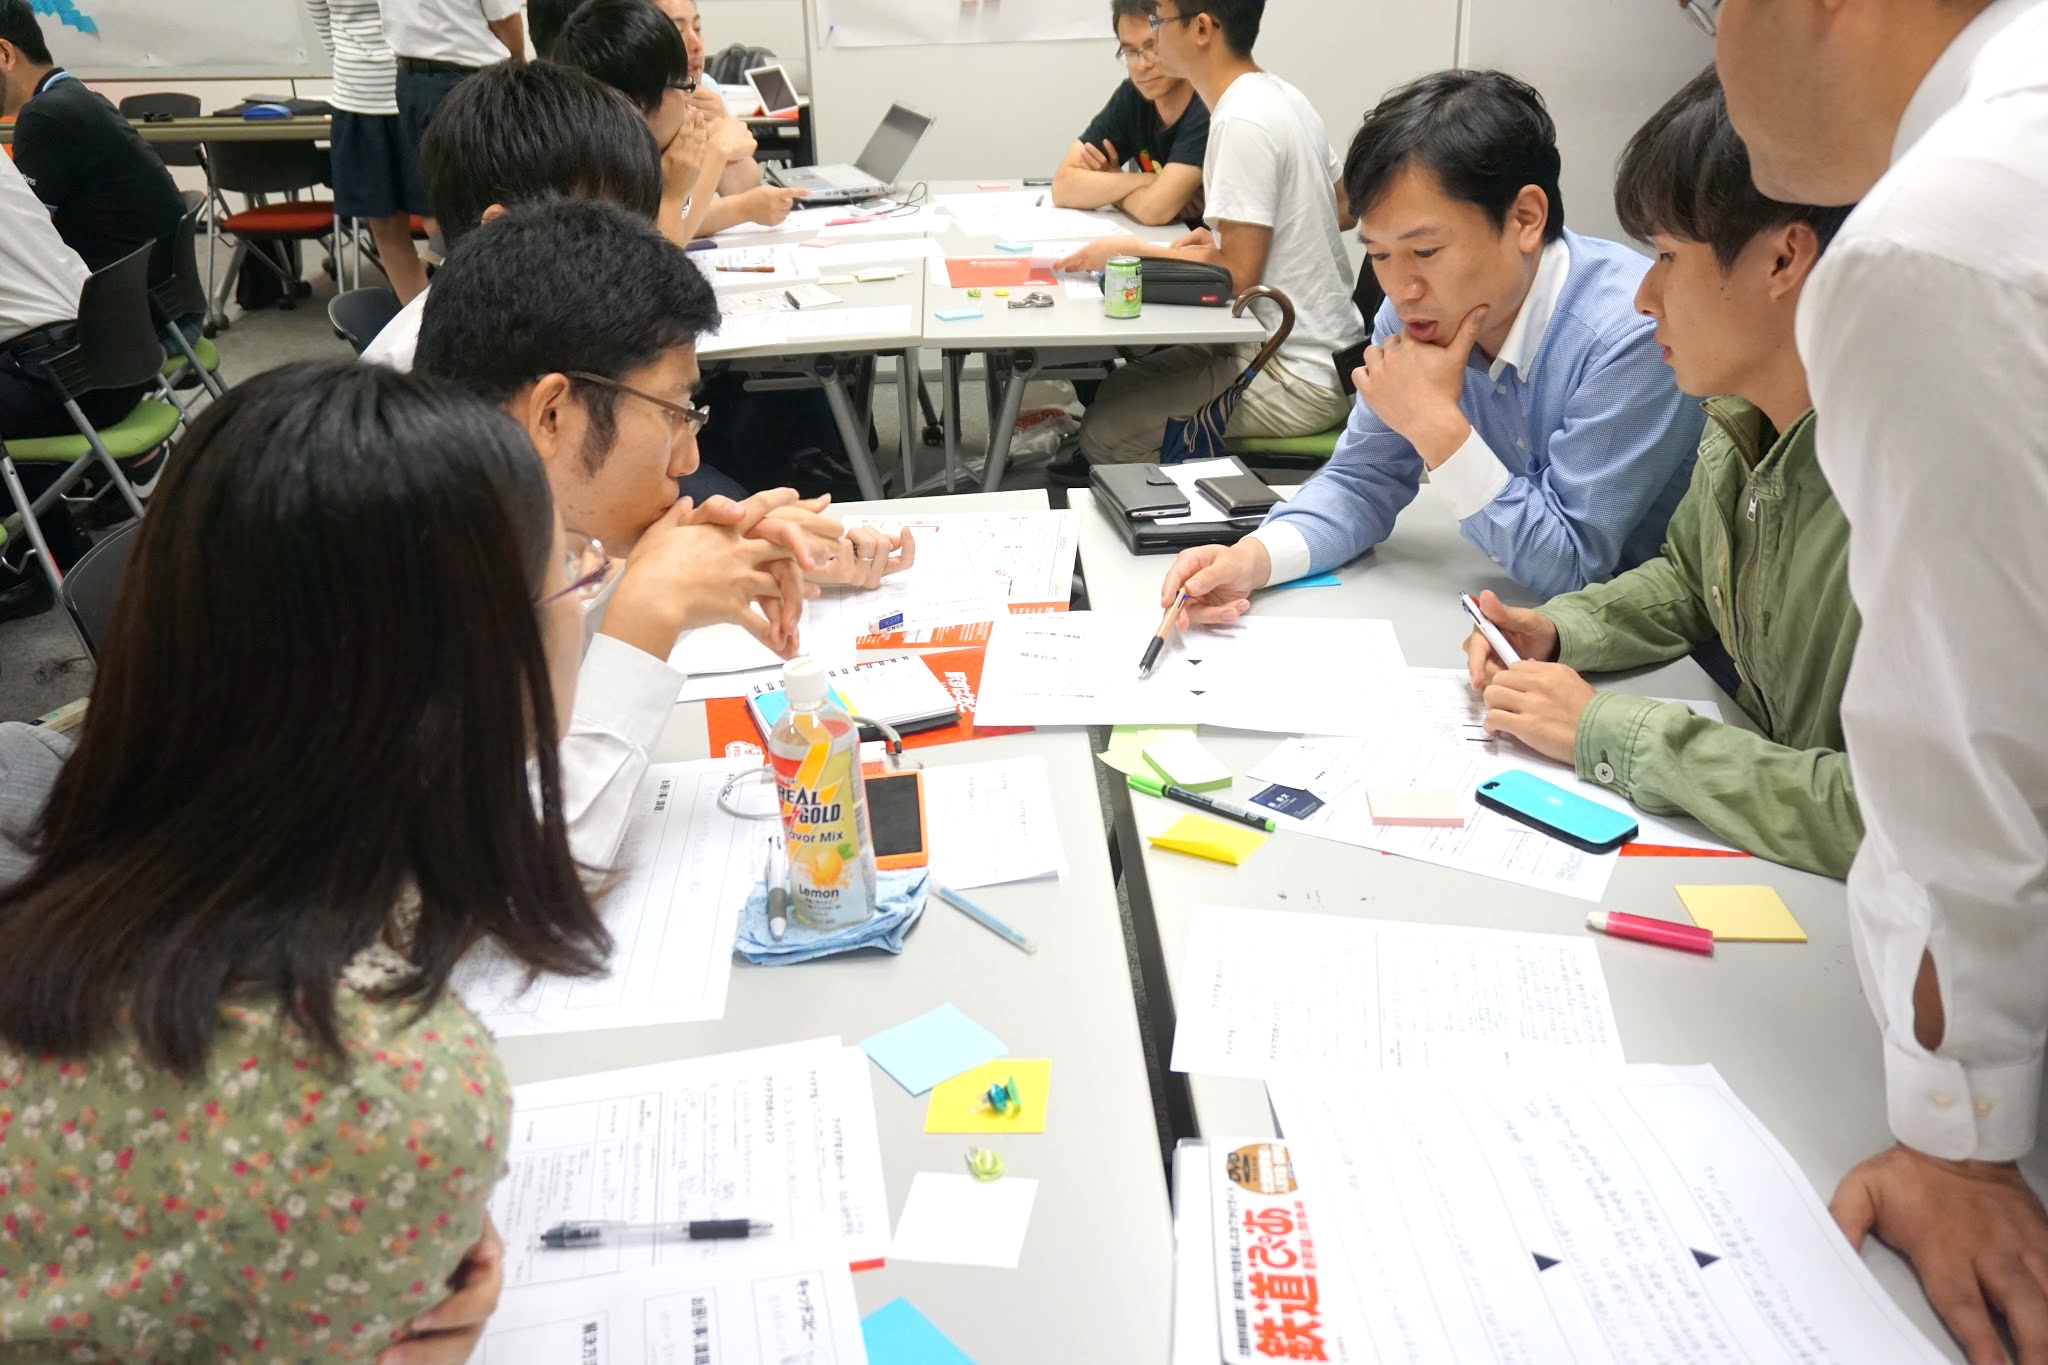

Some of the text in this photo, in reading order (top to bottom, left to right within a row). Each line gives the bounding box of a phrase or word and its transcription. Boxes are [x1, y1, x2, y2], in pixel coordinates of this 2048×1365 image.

[722, 773, 735, 802] キャチコピー
[778, 786, 822, 806] REAL
[798, 804, 841, 825] GOLD
[820, 831, 843, 843] Mix
[799, 884, 839, 899] Lemon
[1242, 1206, 1330, 1363] 鉄道ぴあ
[797, 1279, 816, 1342] キャッチコピー
